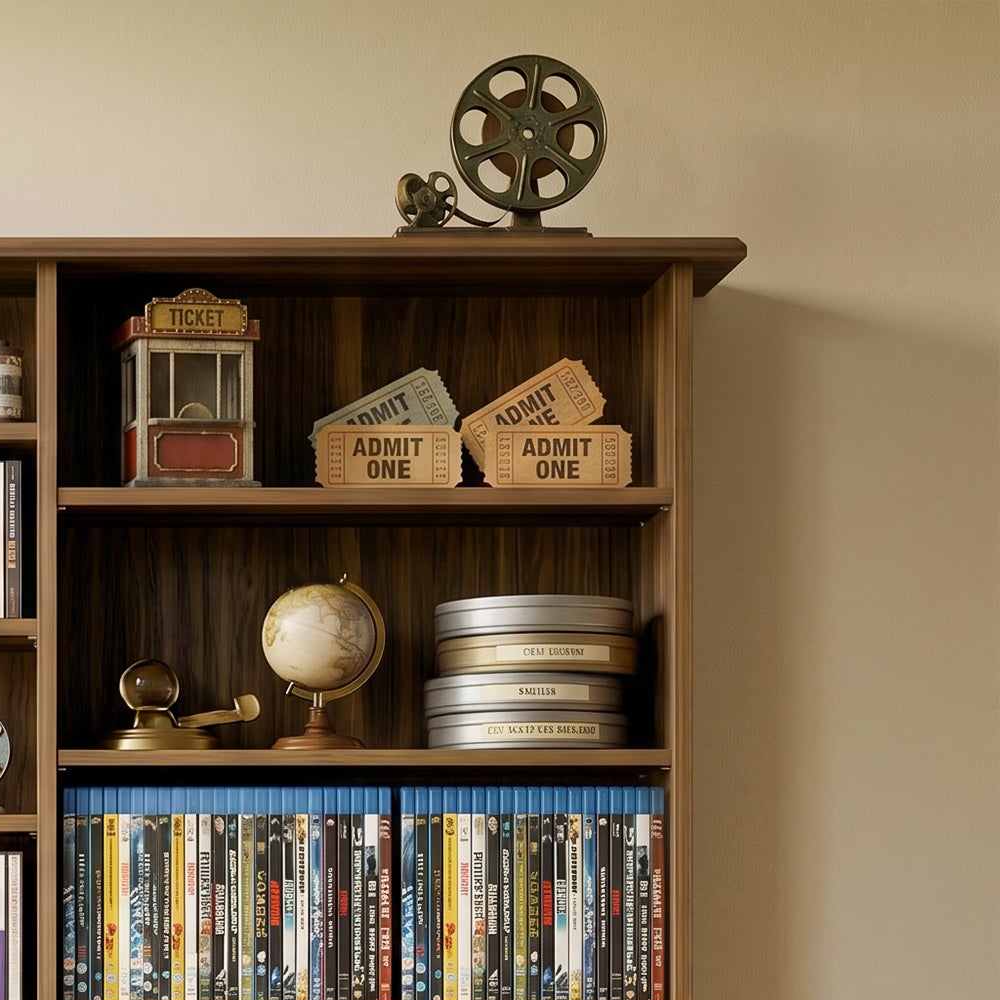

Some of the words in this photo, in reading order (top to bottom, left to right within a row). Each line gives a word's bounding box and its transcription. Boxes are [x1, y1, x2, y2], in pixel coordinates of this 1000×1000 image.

[169, 308, 224, 328] TICKET
[352, 437, 424, 457] ADMIT
[522, 437, 592, 457] ADMIT
[366, 459, 411, 480] ONE
[535, 459, 580, 480] ONE
